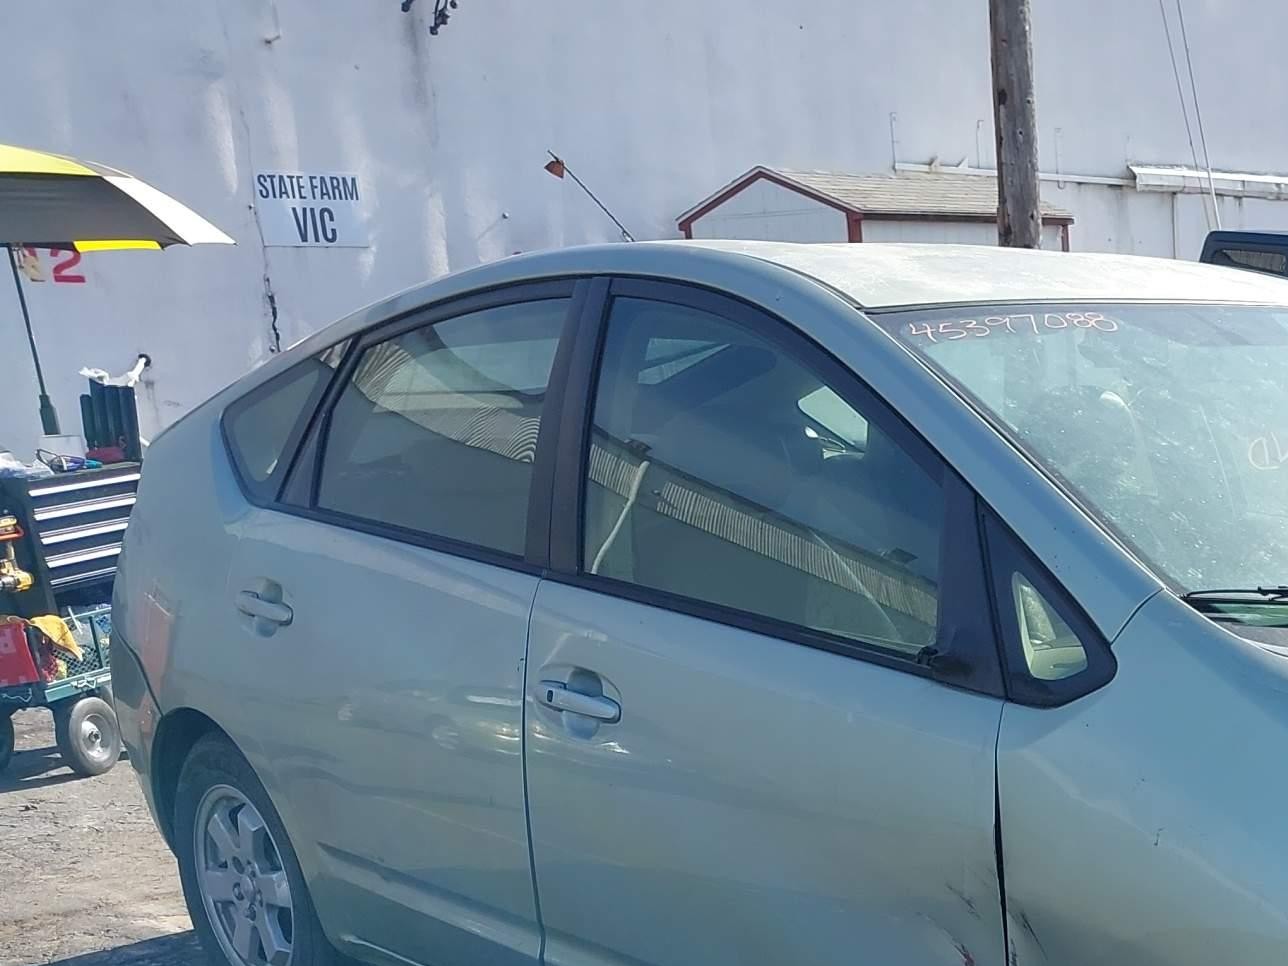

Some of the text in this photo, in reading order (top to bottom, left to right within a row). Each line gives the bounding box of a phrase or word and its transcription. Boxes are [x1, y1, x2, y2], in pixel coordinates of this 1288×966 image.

[257, 174, 359, 200] STATE FARM
[292, 206, 337, 243] VIC
[909, 312, 1118, 343] 45397088
